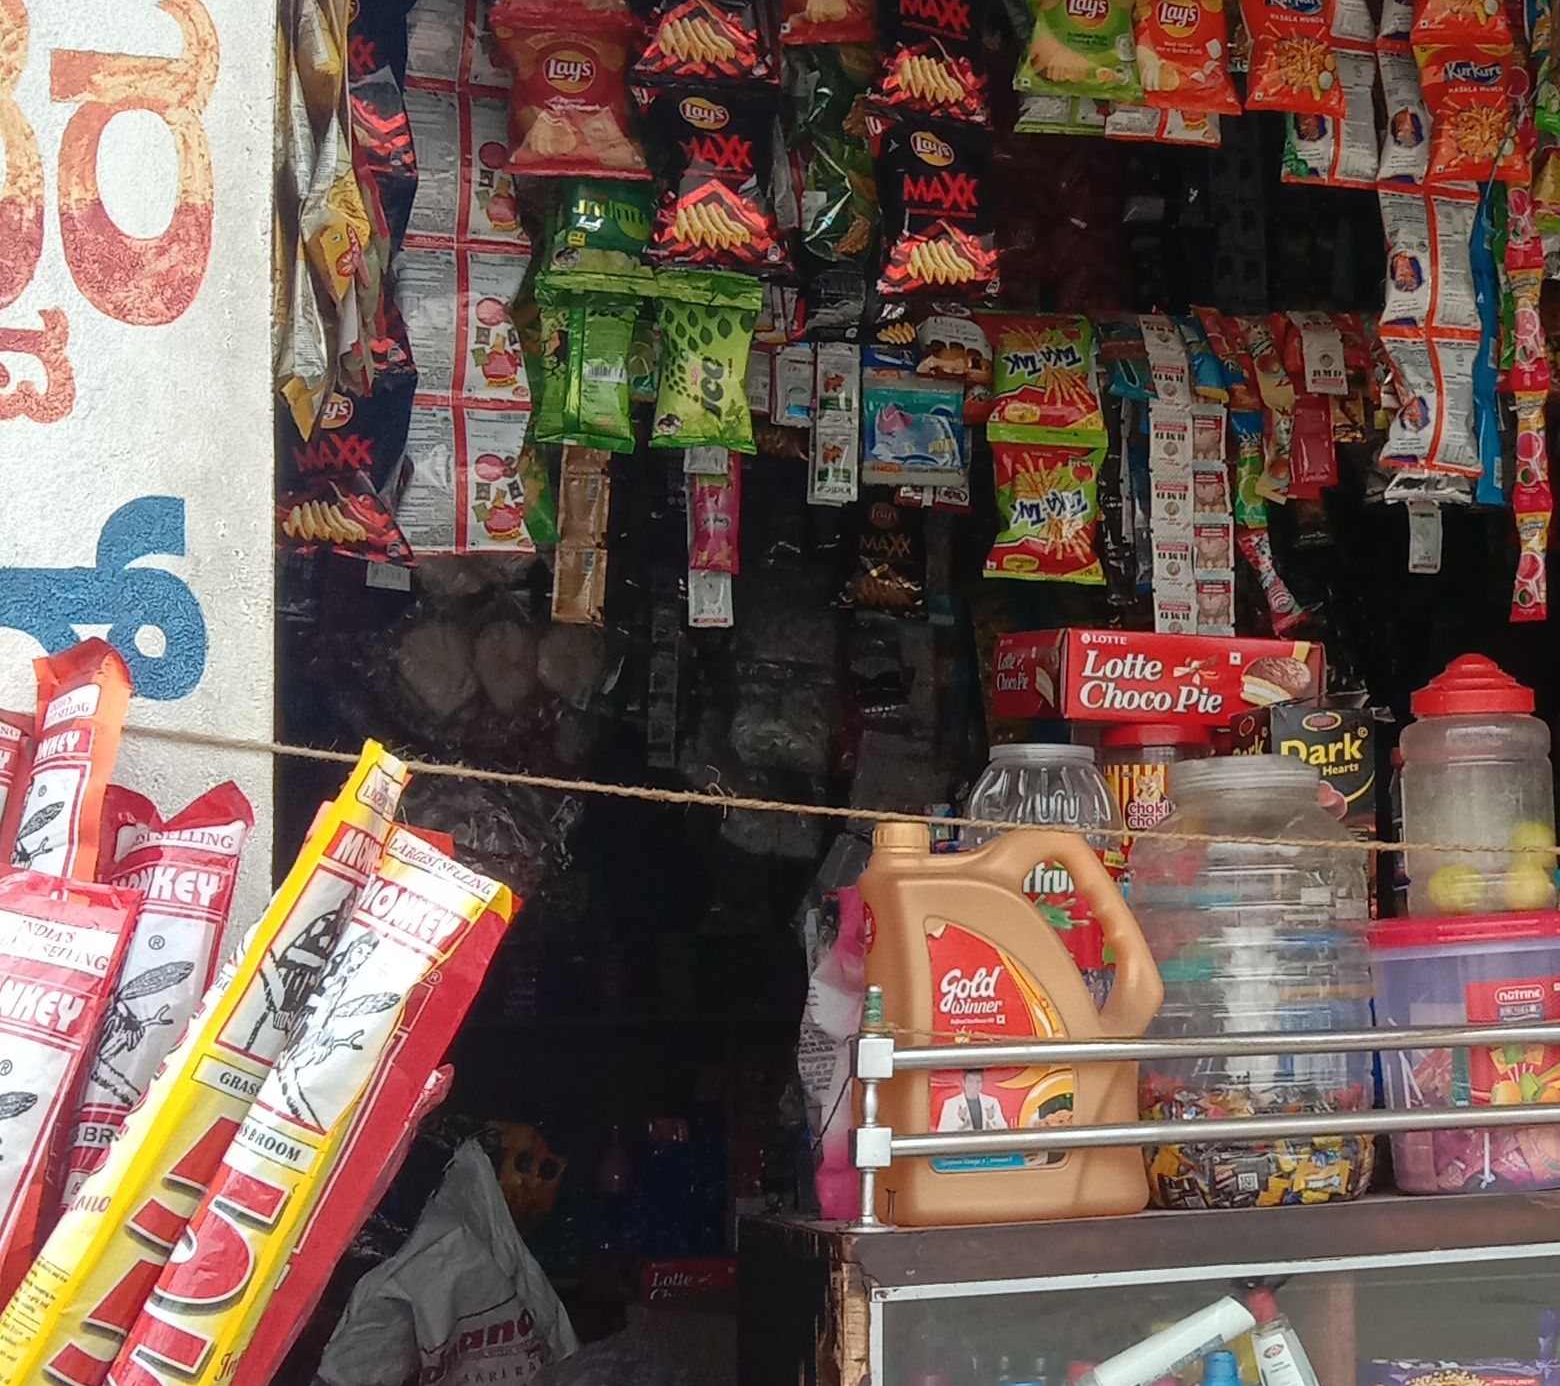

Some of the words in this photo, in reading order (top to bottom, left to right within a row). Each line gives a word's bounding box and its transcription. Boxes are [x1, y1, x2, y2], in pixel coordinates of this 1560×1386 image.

[548, 57, 593, 85] Lay's
[903, 171, 980, 211] MAXX
[1091, 633, 1128, 646] LOTTE
[1081, 650, 1163, 680] Lotte
[1080, 680, 1172, 713] Choco
[1172, 687, 1223, 714] Pie
[1280, 735, 1364, 766] Dark
[1322, 762, 1360, 777] Hearts
[939, 966, 1001, 1013] Gold
[949, 999, 1003, 1015] Winner
